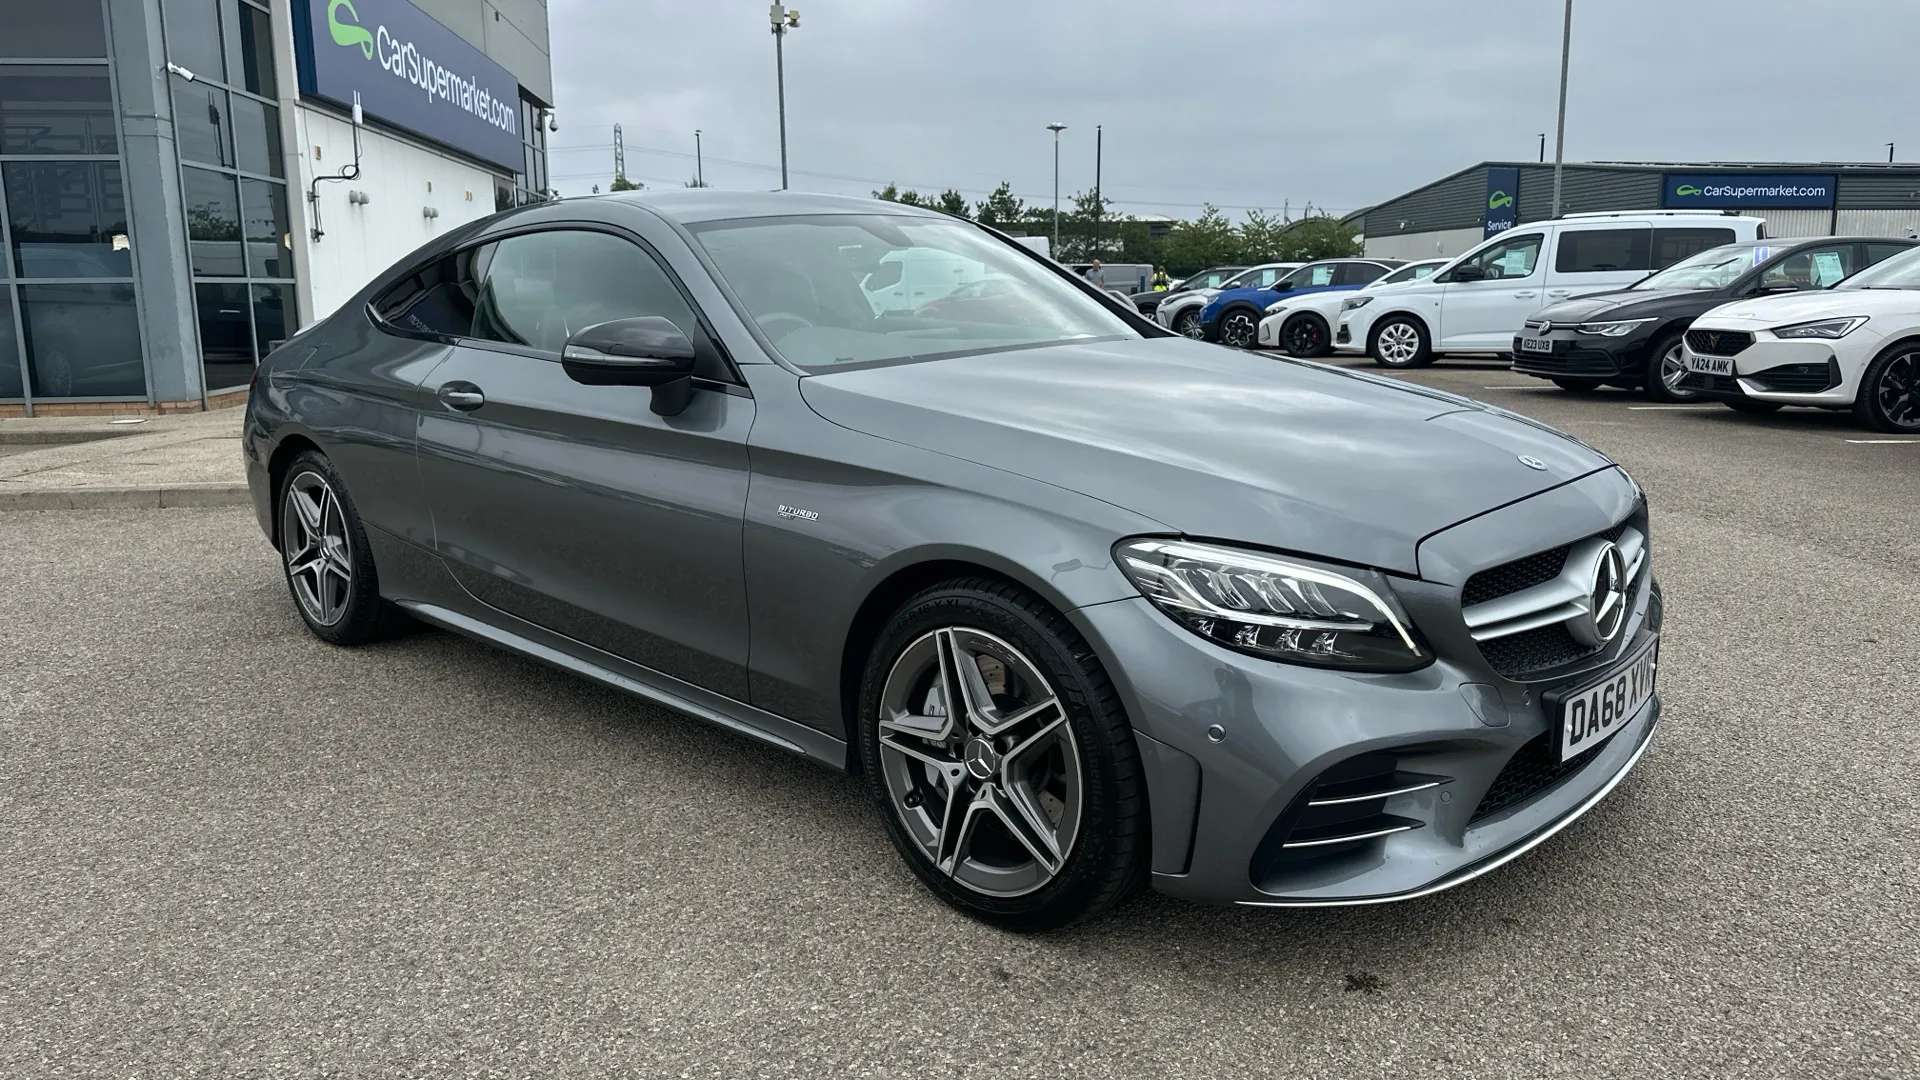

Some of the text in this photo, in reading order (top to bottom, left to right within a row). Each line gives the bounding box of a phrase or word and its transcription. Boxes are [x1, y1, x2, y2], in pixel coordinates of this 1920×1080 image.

[377, 25, 516, 135] CarSupermarket.com
[1703, 185, 1825, 199] CarSupermarket.com
[1487, 219, 1512, 231] Service
[1691, 357, 1730, 373] YA24 AMK
[778, 504, 819, 519] BITURBO
[1569, 675, 1627, 746] DA68
